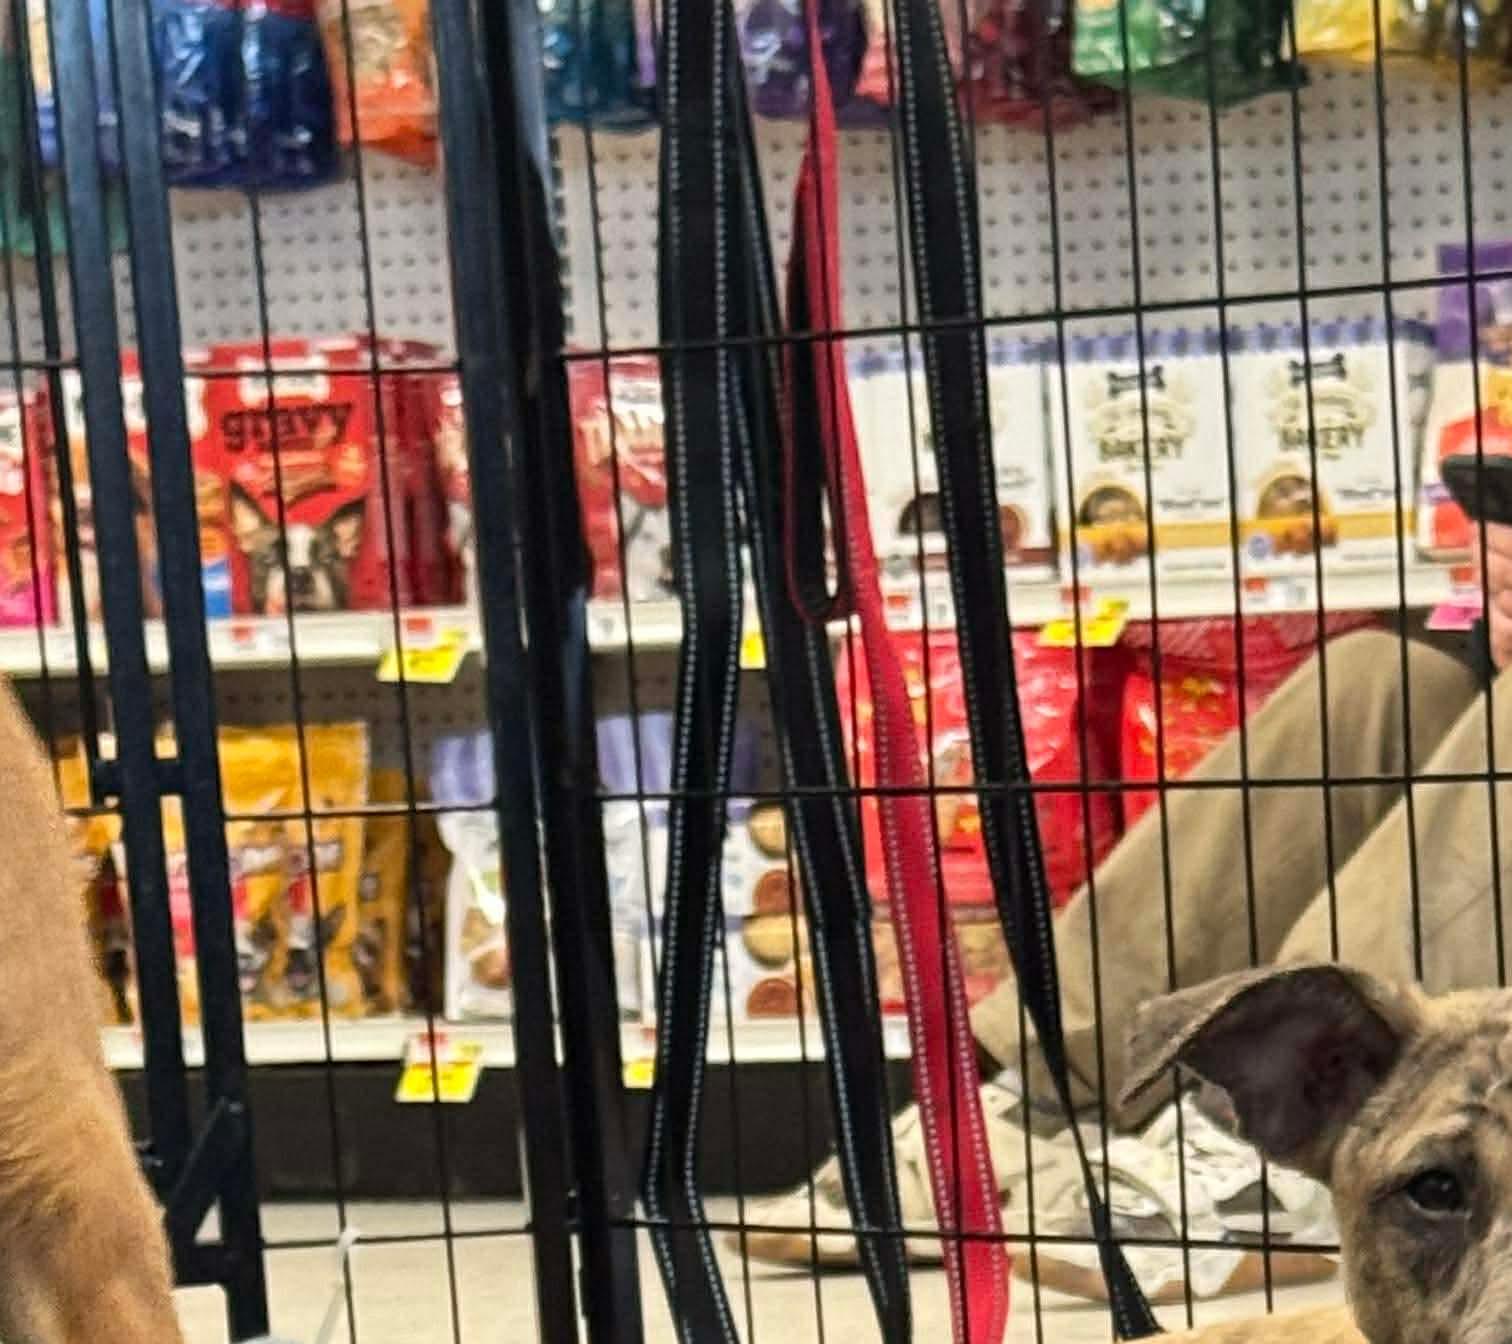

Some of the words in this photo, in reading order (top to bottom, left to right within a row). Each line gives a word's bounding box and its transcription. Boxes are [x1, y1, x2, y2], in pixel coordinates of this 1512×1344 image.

[220, 403, 353, 453] gravy
[1279, 425, 1365, 449] BAERY
[1098, 436, 1184, 461] BAKRY
